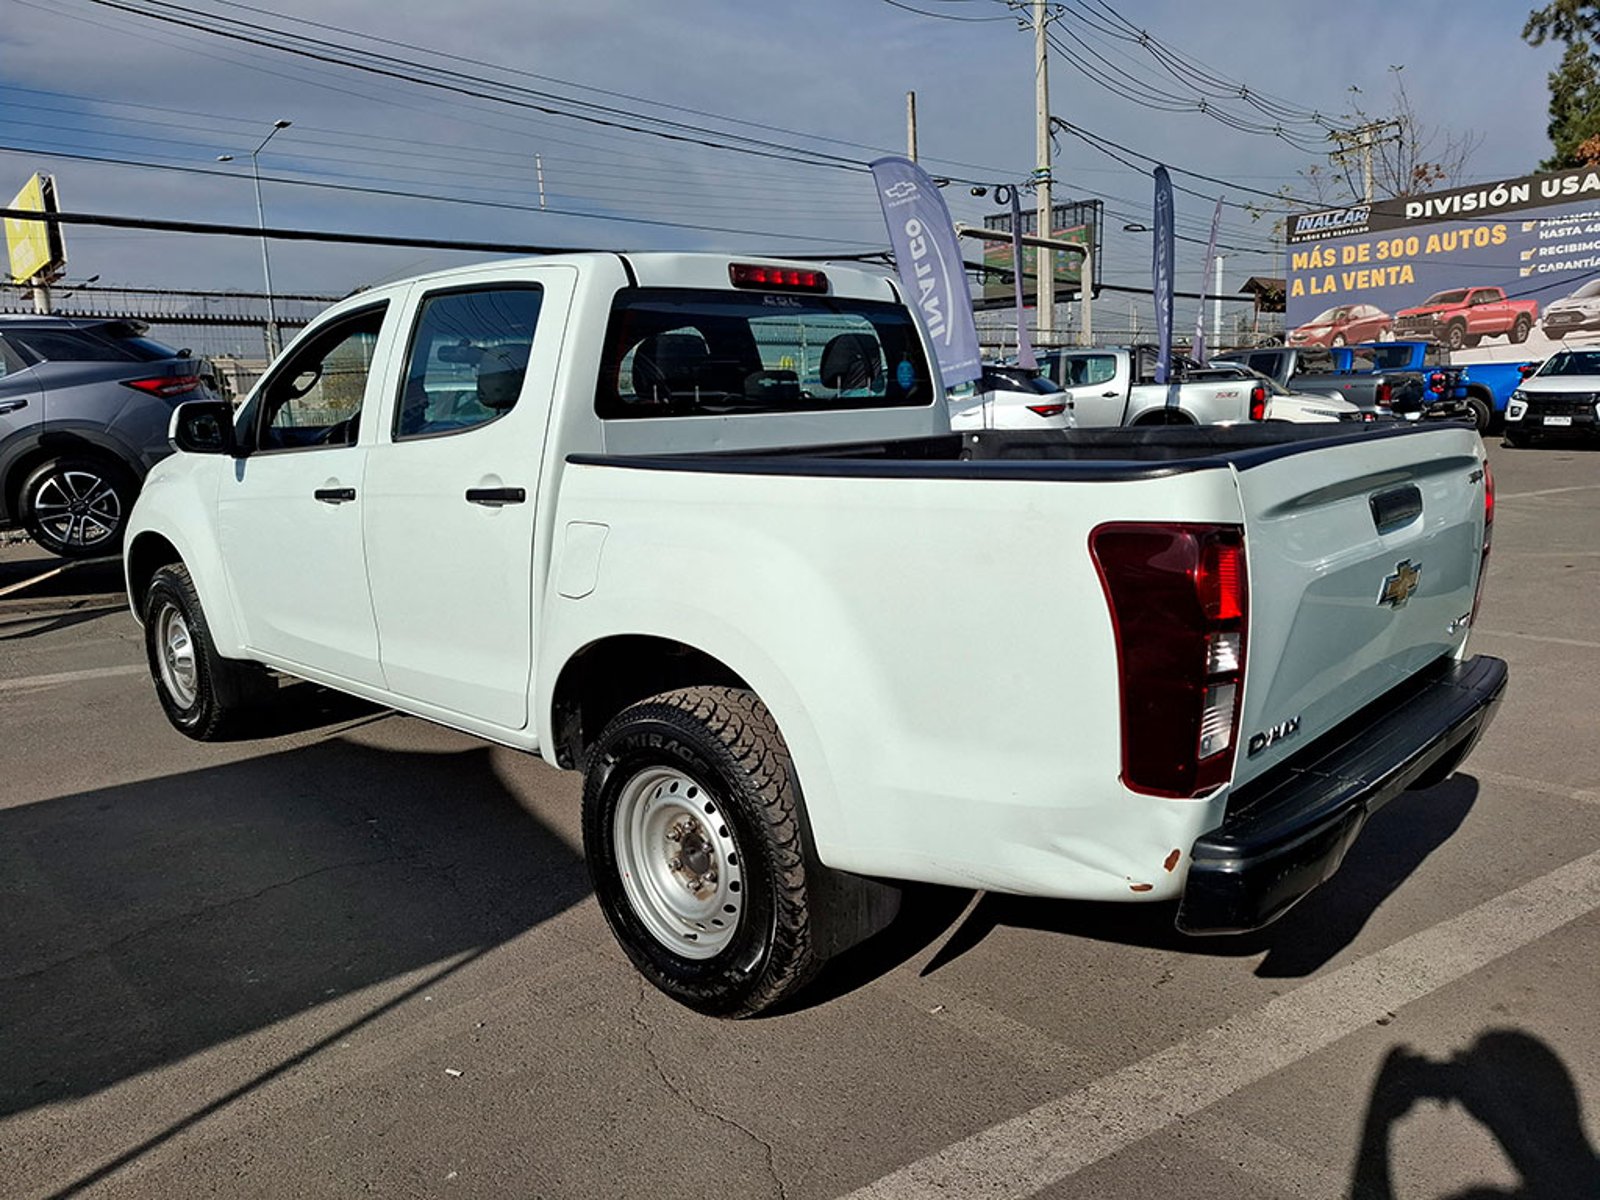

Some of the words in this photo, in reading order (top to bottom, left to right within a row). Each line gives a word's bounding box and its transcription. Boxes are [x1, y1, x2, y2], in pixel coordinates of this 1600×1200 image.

[1405, 183, 1530, 219] DIVISIÓN
[1540, 173, 1600, 199] USA
[1292, 244, 1337, 272] MÁS
[1342, 243, 1371, 265] DE
[1376, 236, 1419, 259] 300
[1425, 224, 1507, 254] AUTOS
[1539, 226, 1582, 239] HASTA
[1290, 278, 1305, 297] A
[1310, 274, 1337, 294] LA
[1342, 264, 1414, 291] VENTA
